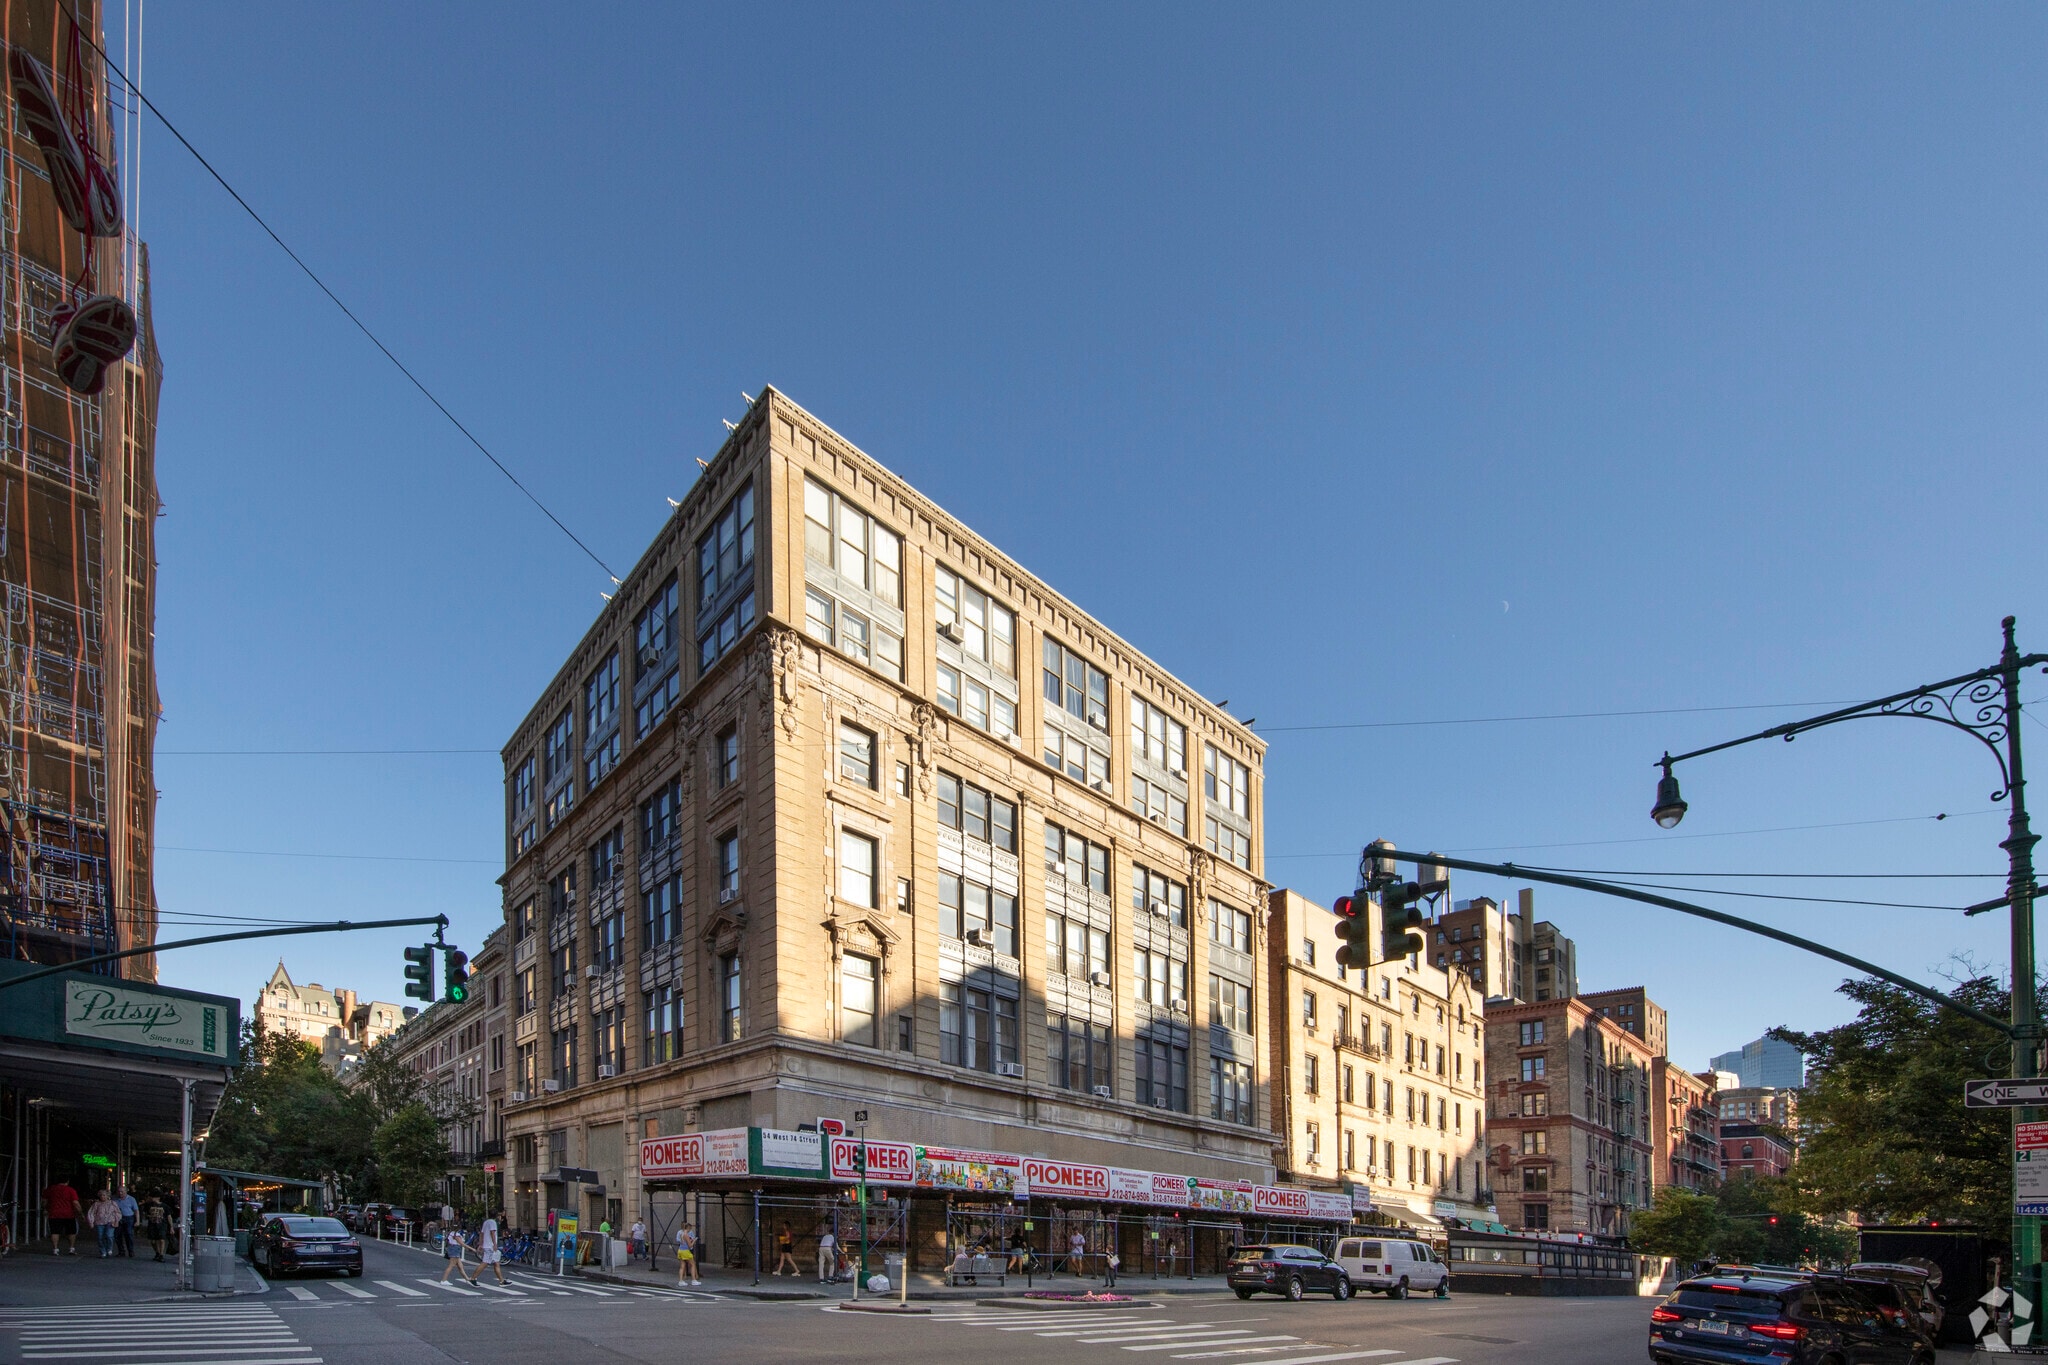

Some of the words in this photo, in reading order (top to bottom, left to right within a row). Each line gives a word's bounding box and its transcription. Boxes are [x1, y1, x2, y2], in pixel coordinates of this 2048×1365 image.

[73, 989, 182, 1033] Patsy's
[149, 1033, 172, 1043] Since
[174, 1037, 194, 1046] 1933
[1982, 1088, 2018, 1099] ONE
[773, 1133, 789, 1142] West
[799, 1135, 819, 1144] Street
[643, 1140, 700, 1166] PIONEER
[2019, 1151, 2027, 1161] 2
[1027, 1163, 1106, 1187] PIONEER
[1153, 1176, 1185, 1190] PIONEER
[882, 1190, 887, 1201] 3
[1111, 1189, 1150, 1202] 212-874-9506
[1152, 1194, 1187, 1205] 212-874-9506
[1257, 1189, 1307, 1208] PIONEER
